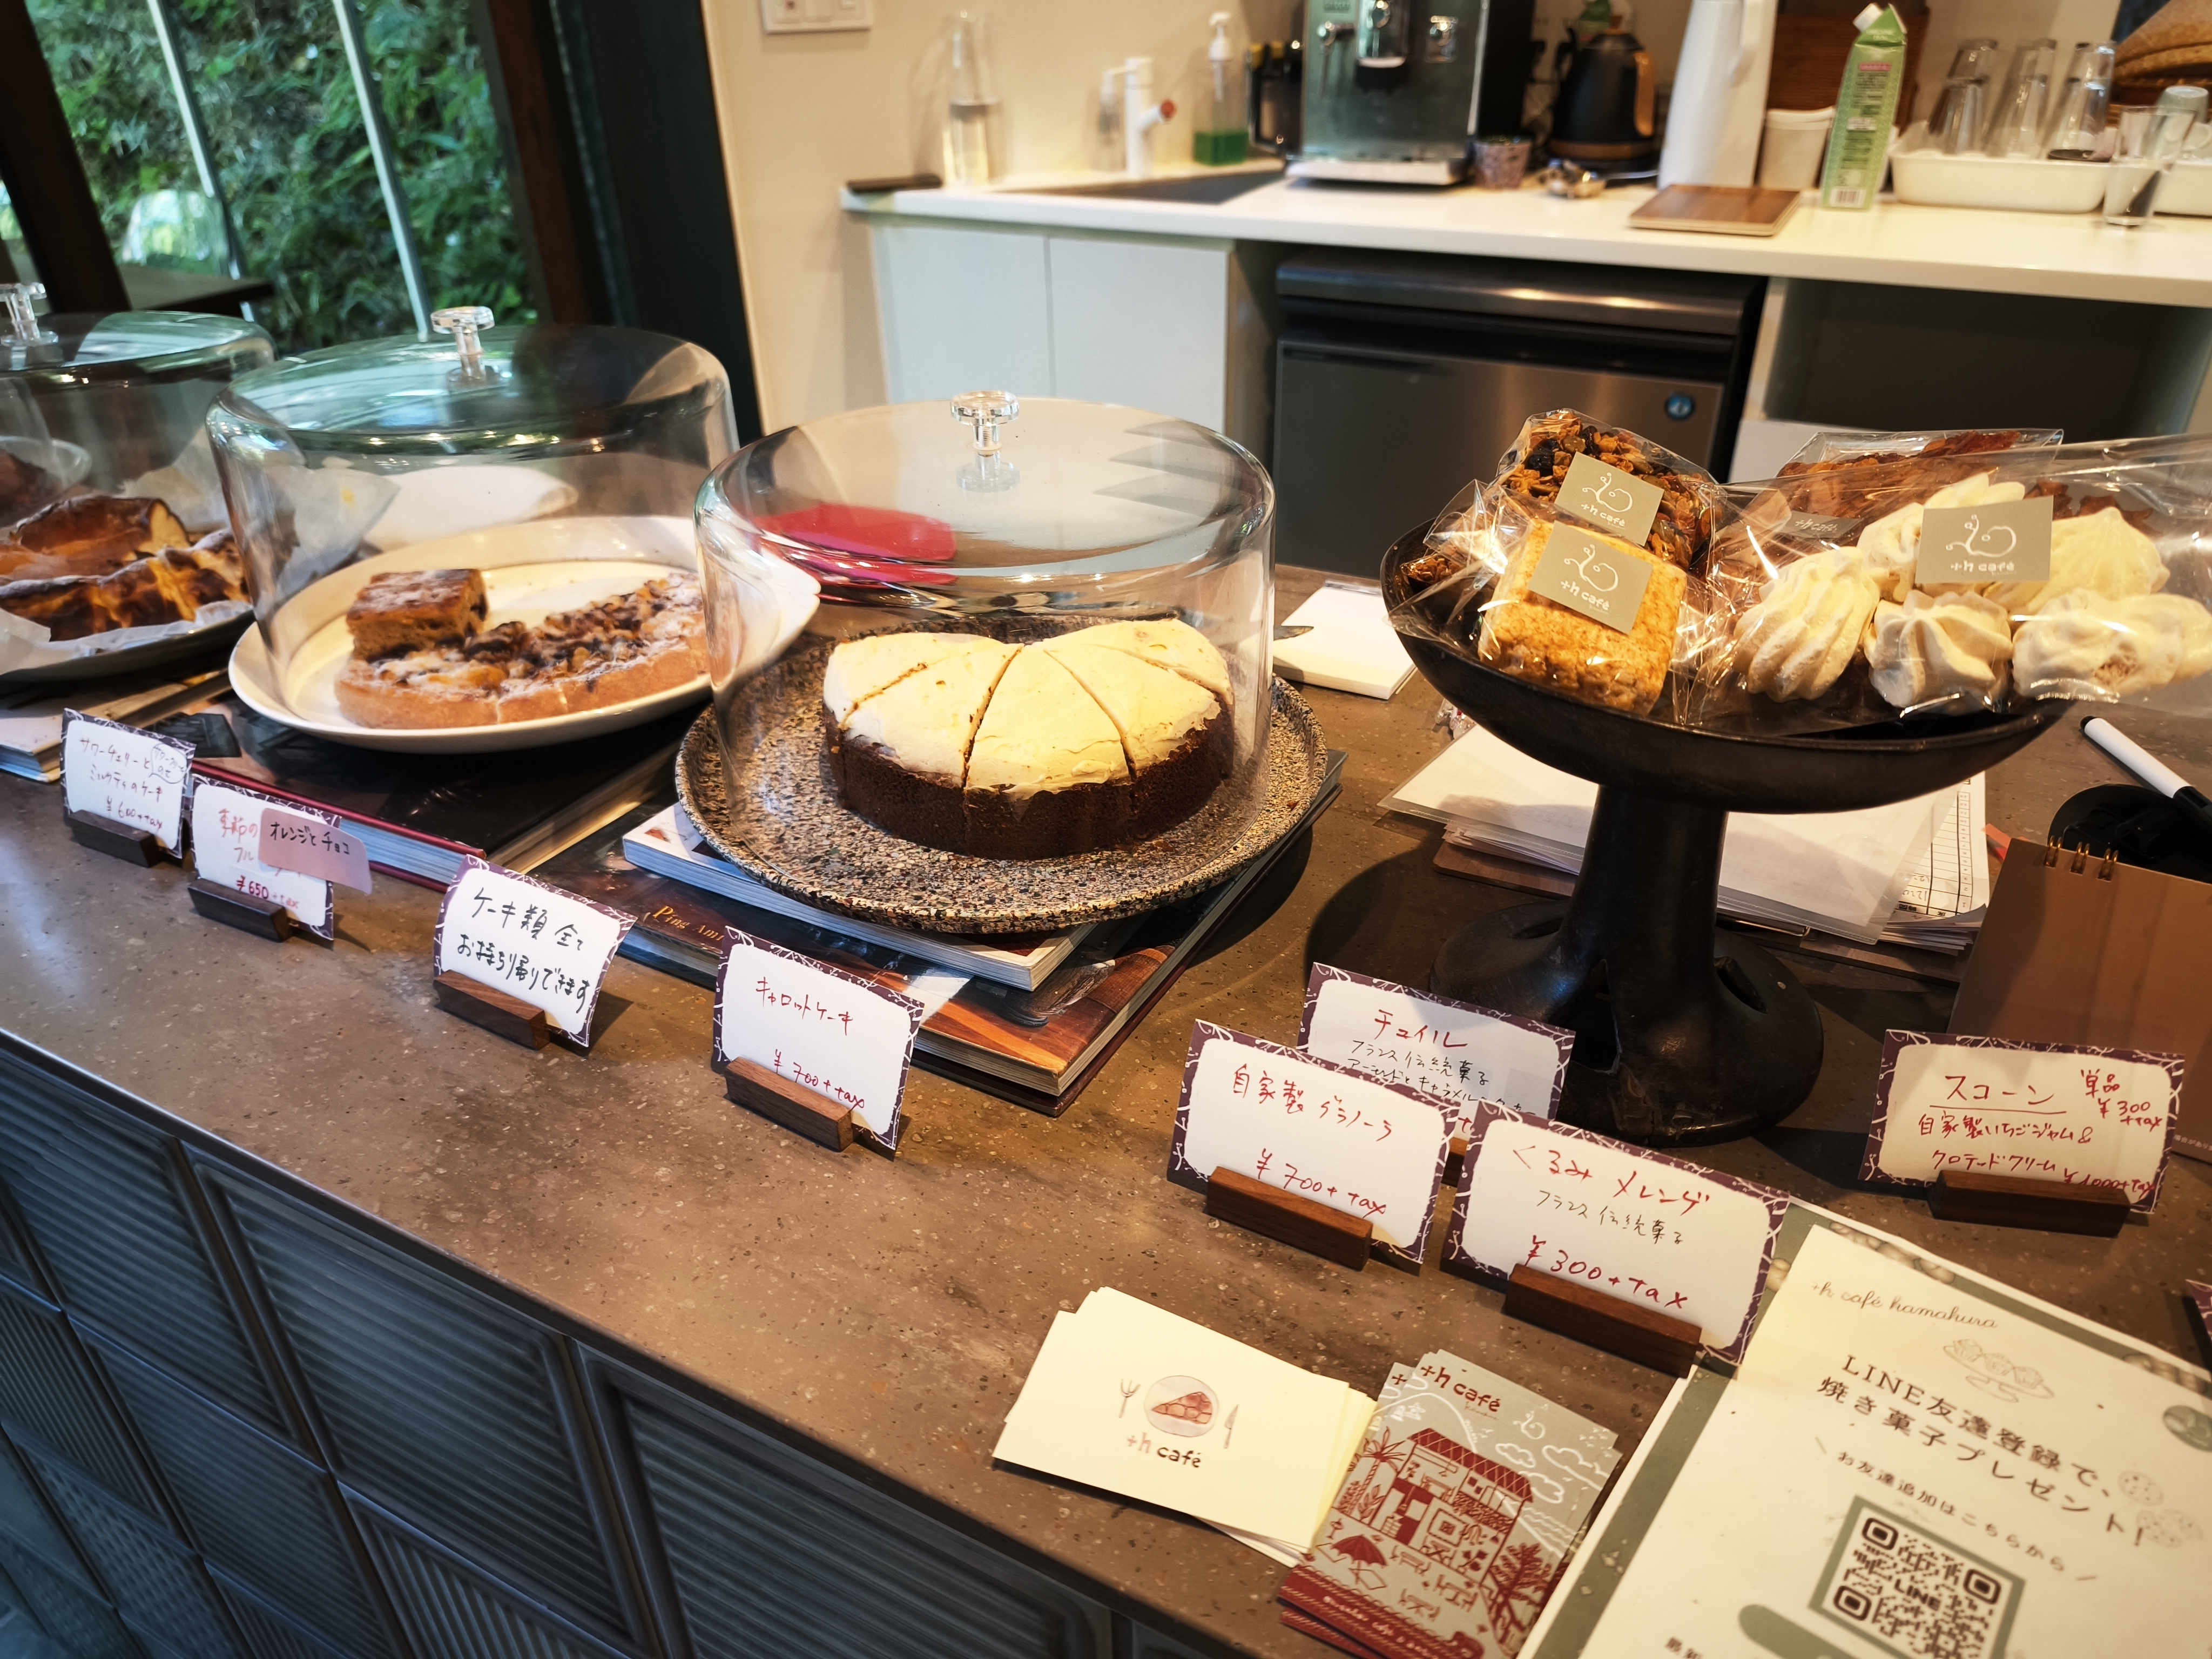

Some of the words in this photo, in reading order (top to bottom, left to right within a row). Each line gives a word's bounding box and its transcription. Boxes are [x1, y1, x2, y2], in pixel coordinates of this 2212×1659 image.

[1600, 512, 1626, 527] café
[1581, 591, 1610, 611] café
[457, 934, 591, 1014] お持ち帰りできます
[756, 976, 853, 1036] キャロットケーキ
[1374, 1009, 1468, 1048] チュイル
[1944, 1075, 2054, 1105] スコーン
[2080, 1068, 2120, 1098] 単品
[1840, 1290, 1884, 1310] café
[1453, 1382, 1501, 1413] café
[1156, 1446, 1202, 1468] café
[1837, 1451, 2066, 1573] お友達追加はこちらから
[1893, 1578, 1942, 1611] LINE
